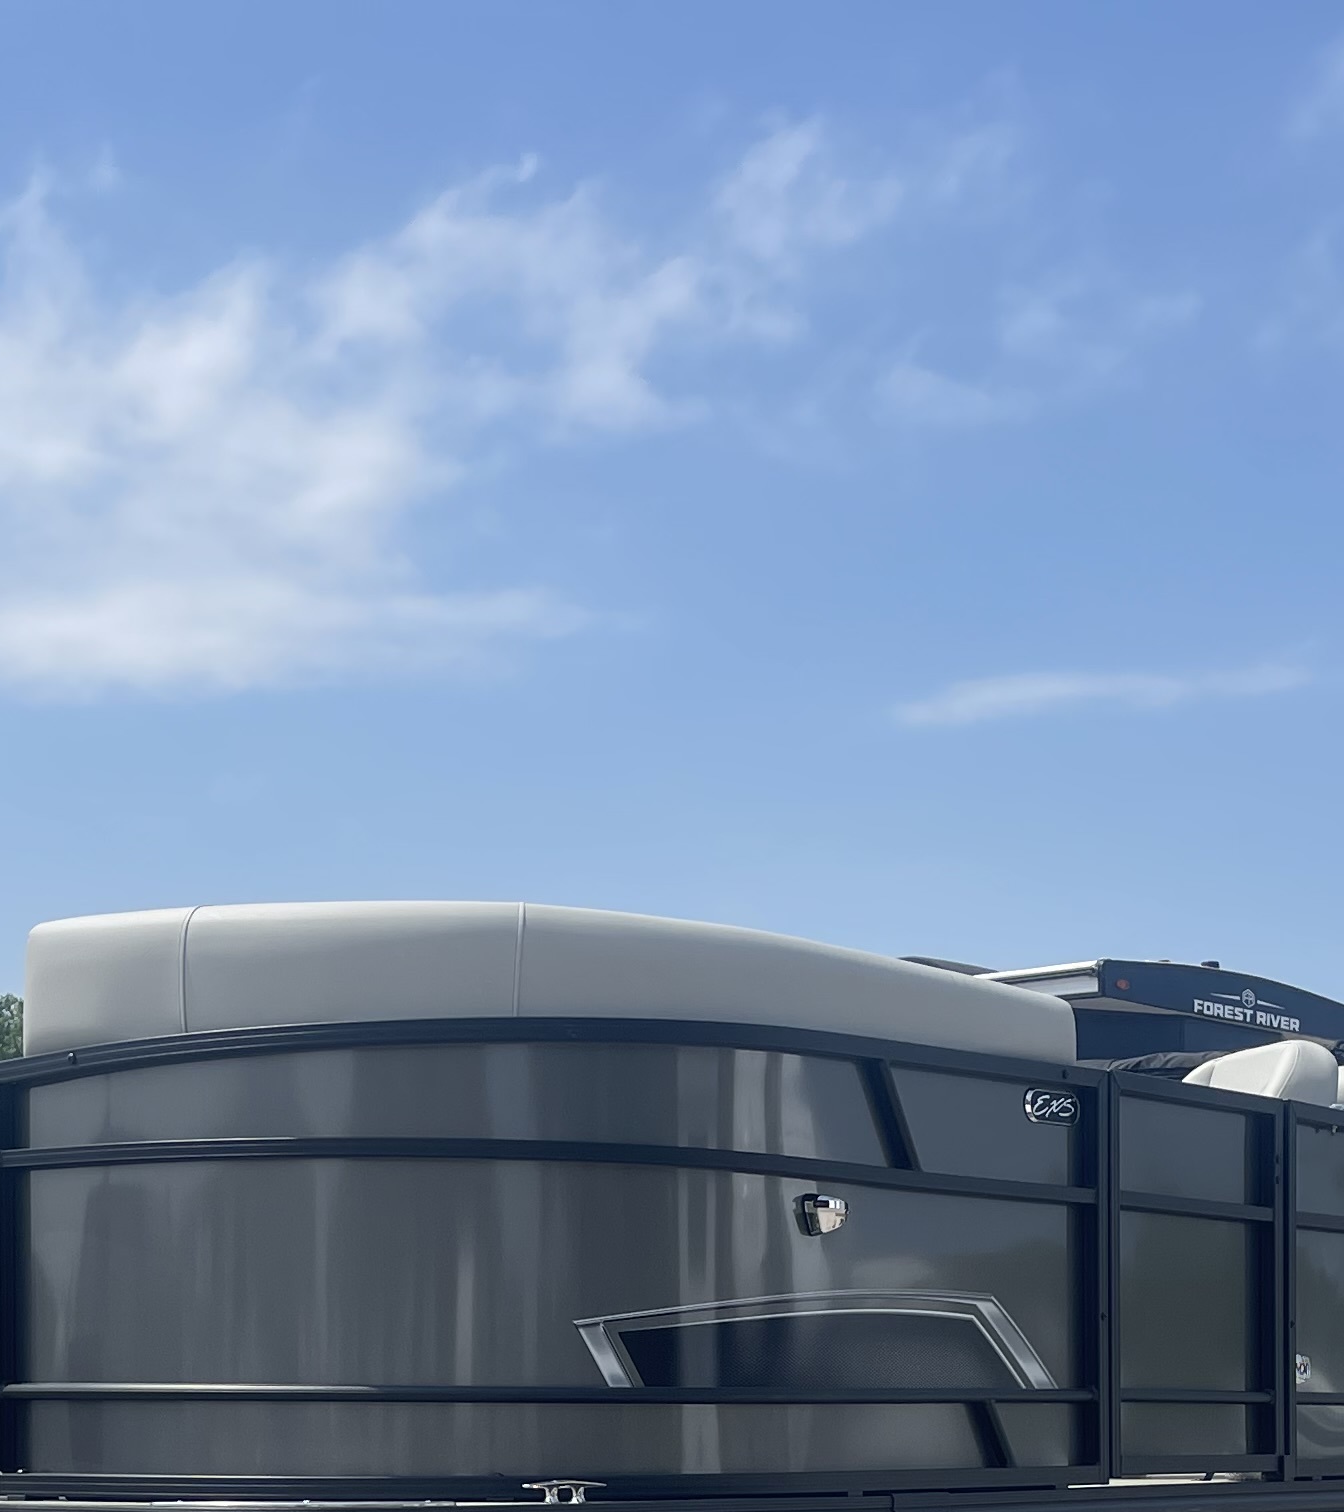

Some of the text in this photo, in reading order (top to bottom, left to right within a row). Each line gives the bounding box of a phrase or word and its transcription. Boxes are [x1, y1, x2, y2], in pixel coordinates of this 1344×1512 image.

[1193, 999, 1300, 1032] FOREST RIVER
[1033, 1094, 1075, 1118] EXS
